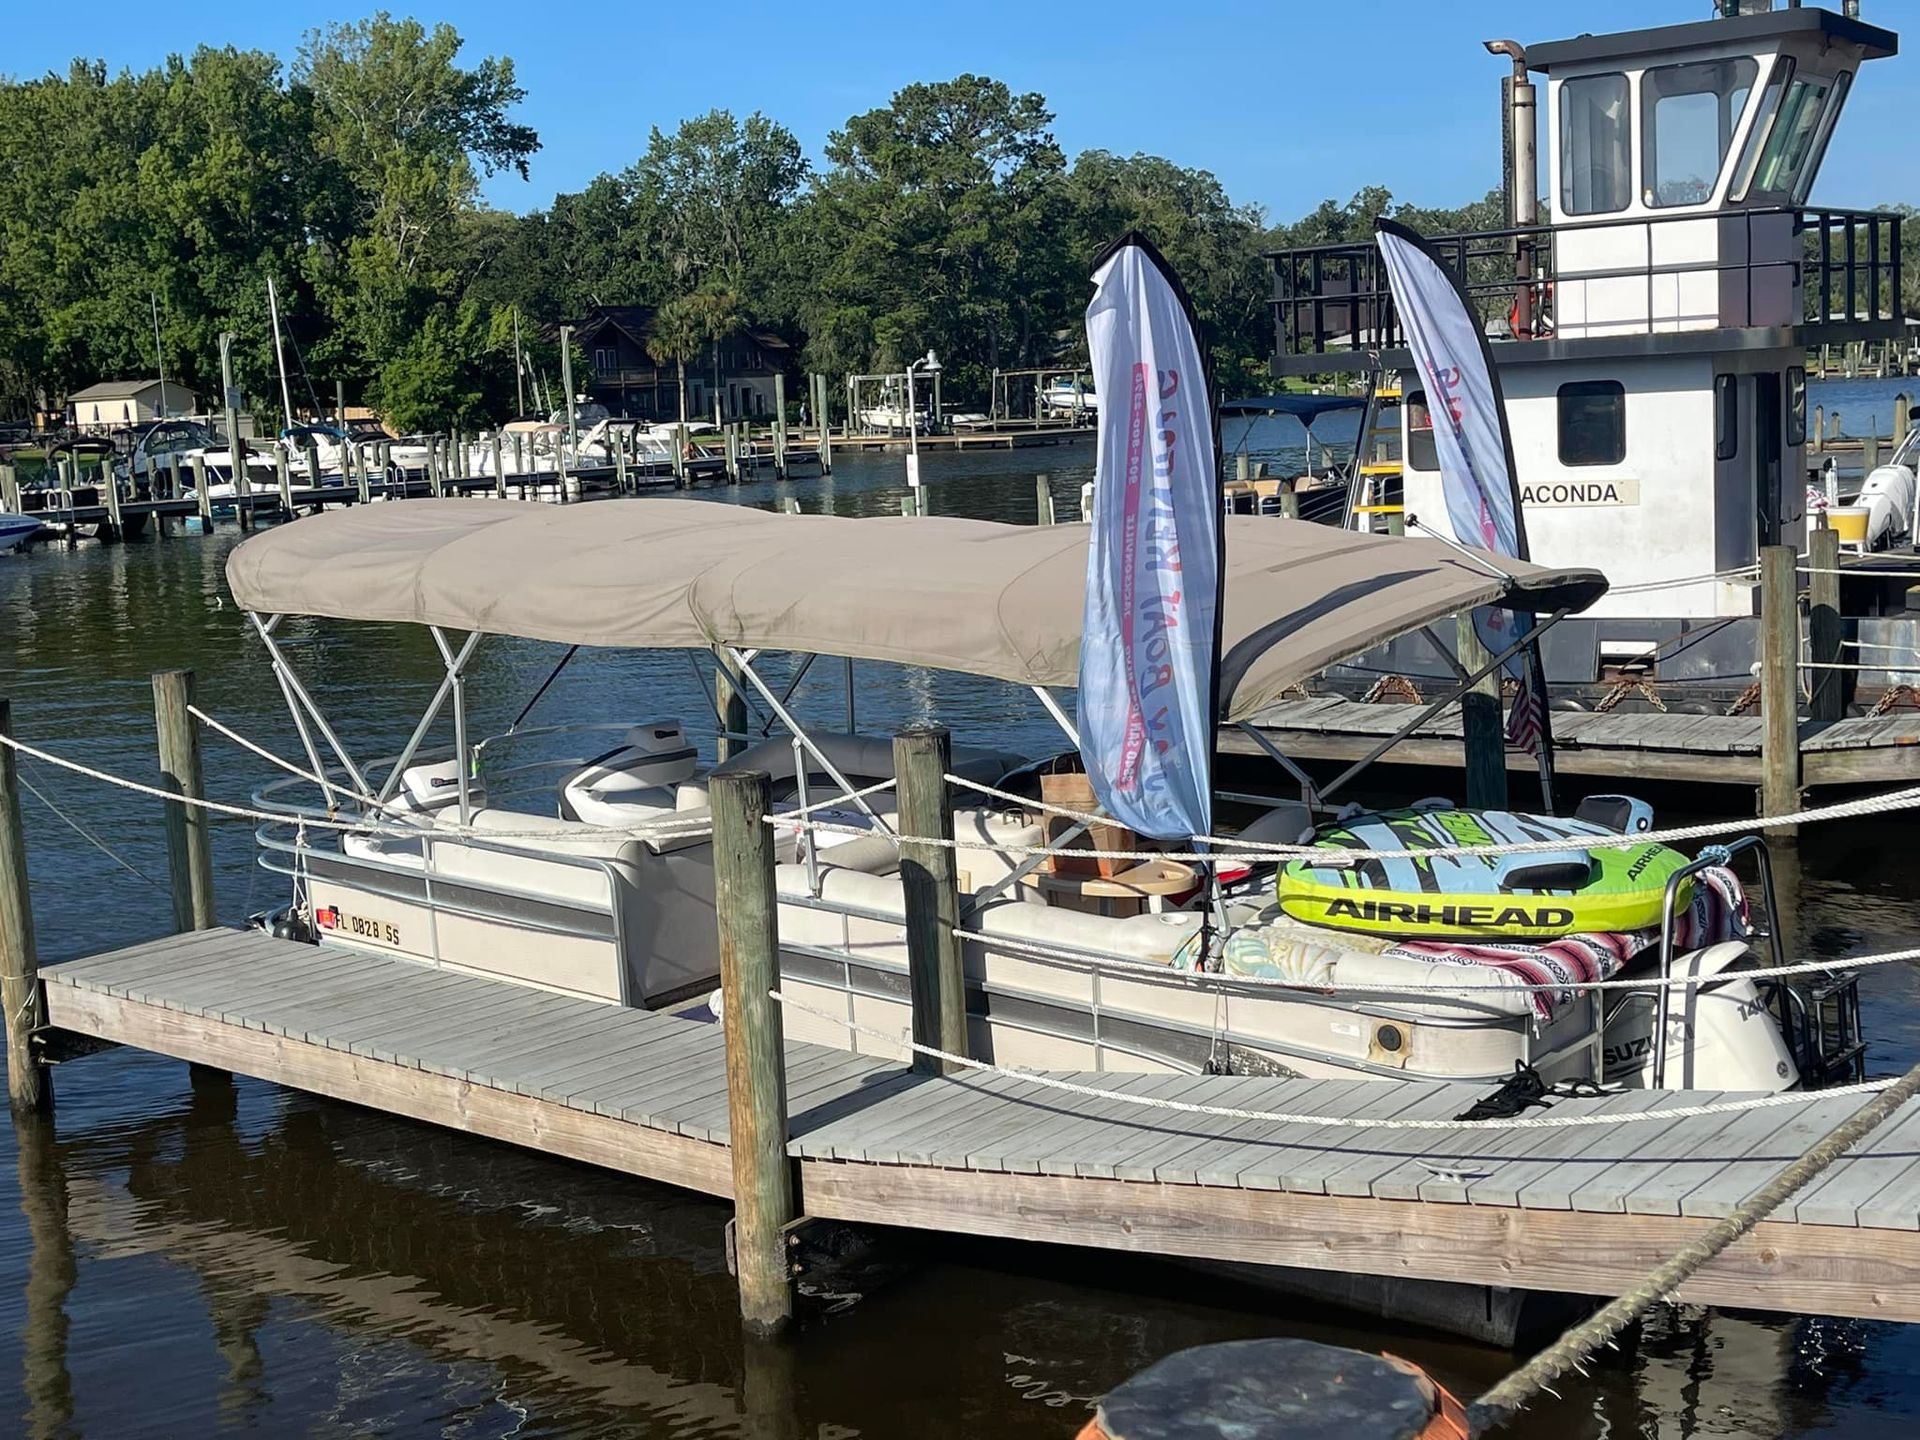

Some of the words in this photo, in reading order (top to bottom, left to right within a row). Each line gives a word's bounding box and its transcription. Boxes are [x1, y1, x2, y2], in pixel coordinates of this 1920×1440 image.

[1324, 898, 1575, 928] AIRHEAD
[335, 914, 348, 930] FL
[351, 916, 380, 938] 0828
[385, 925, 400, 946] SS
